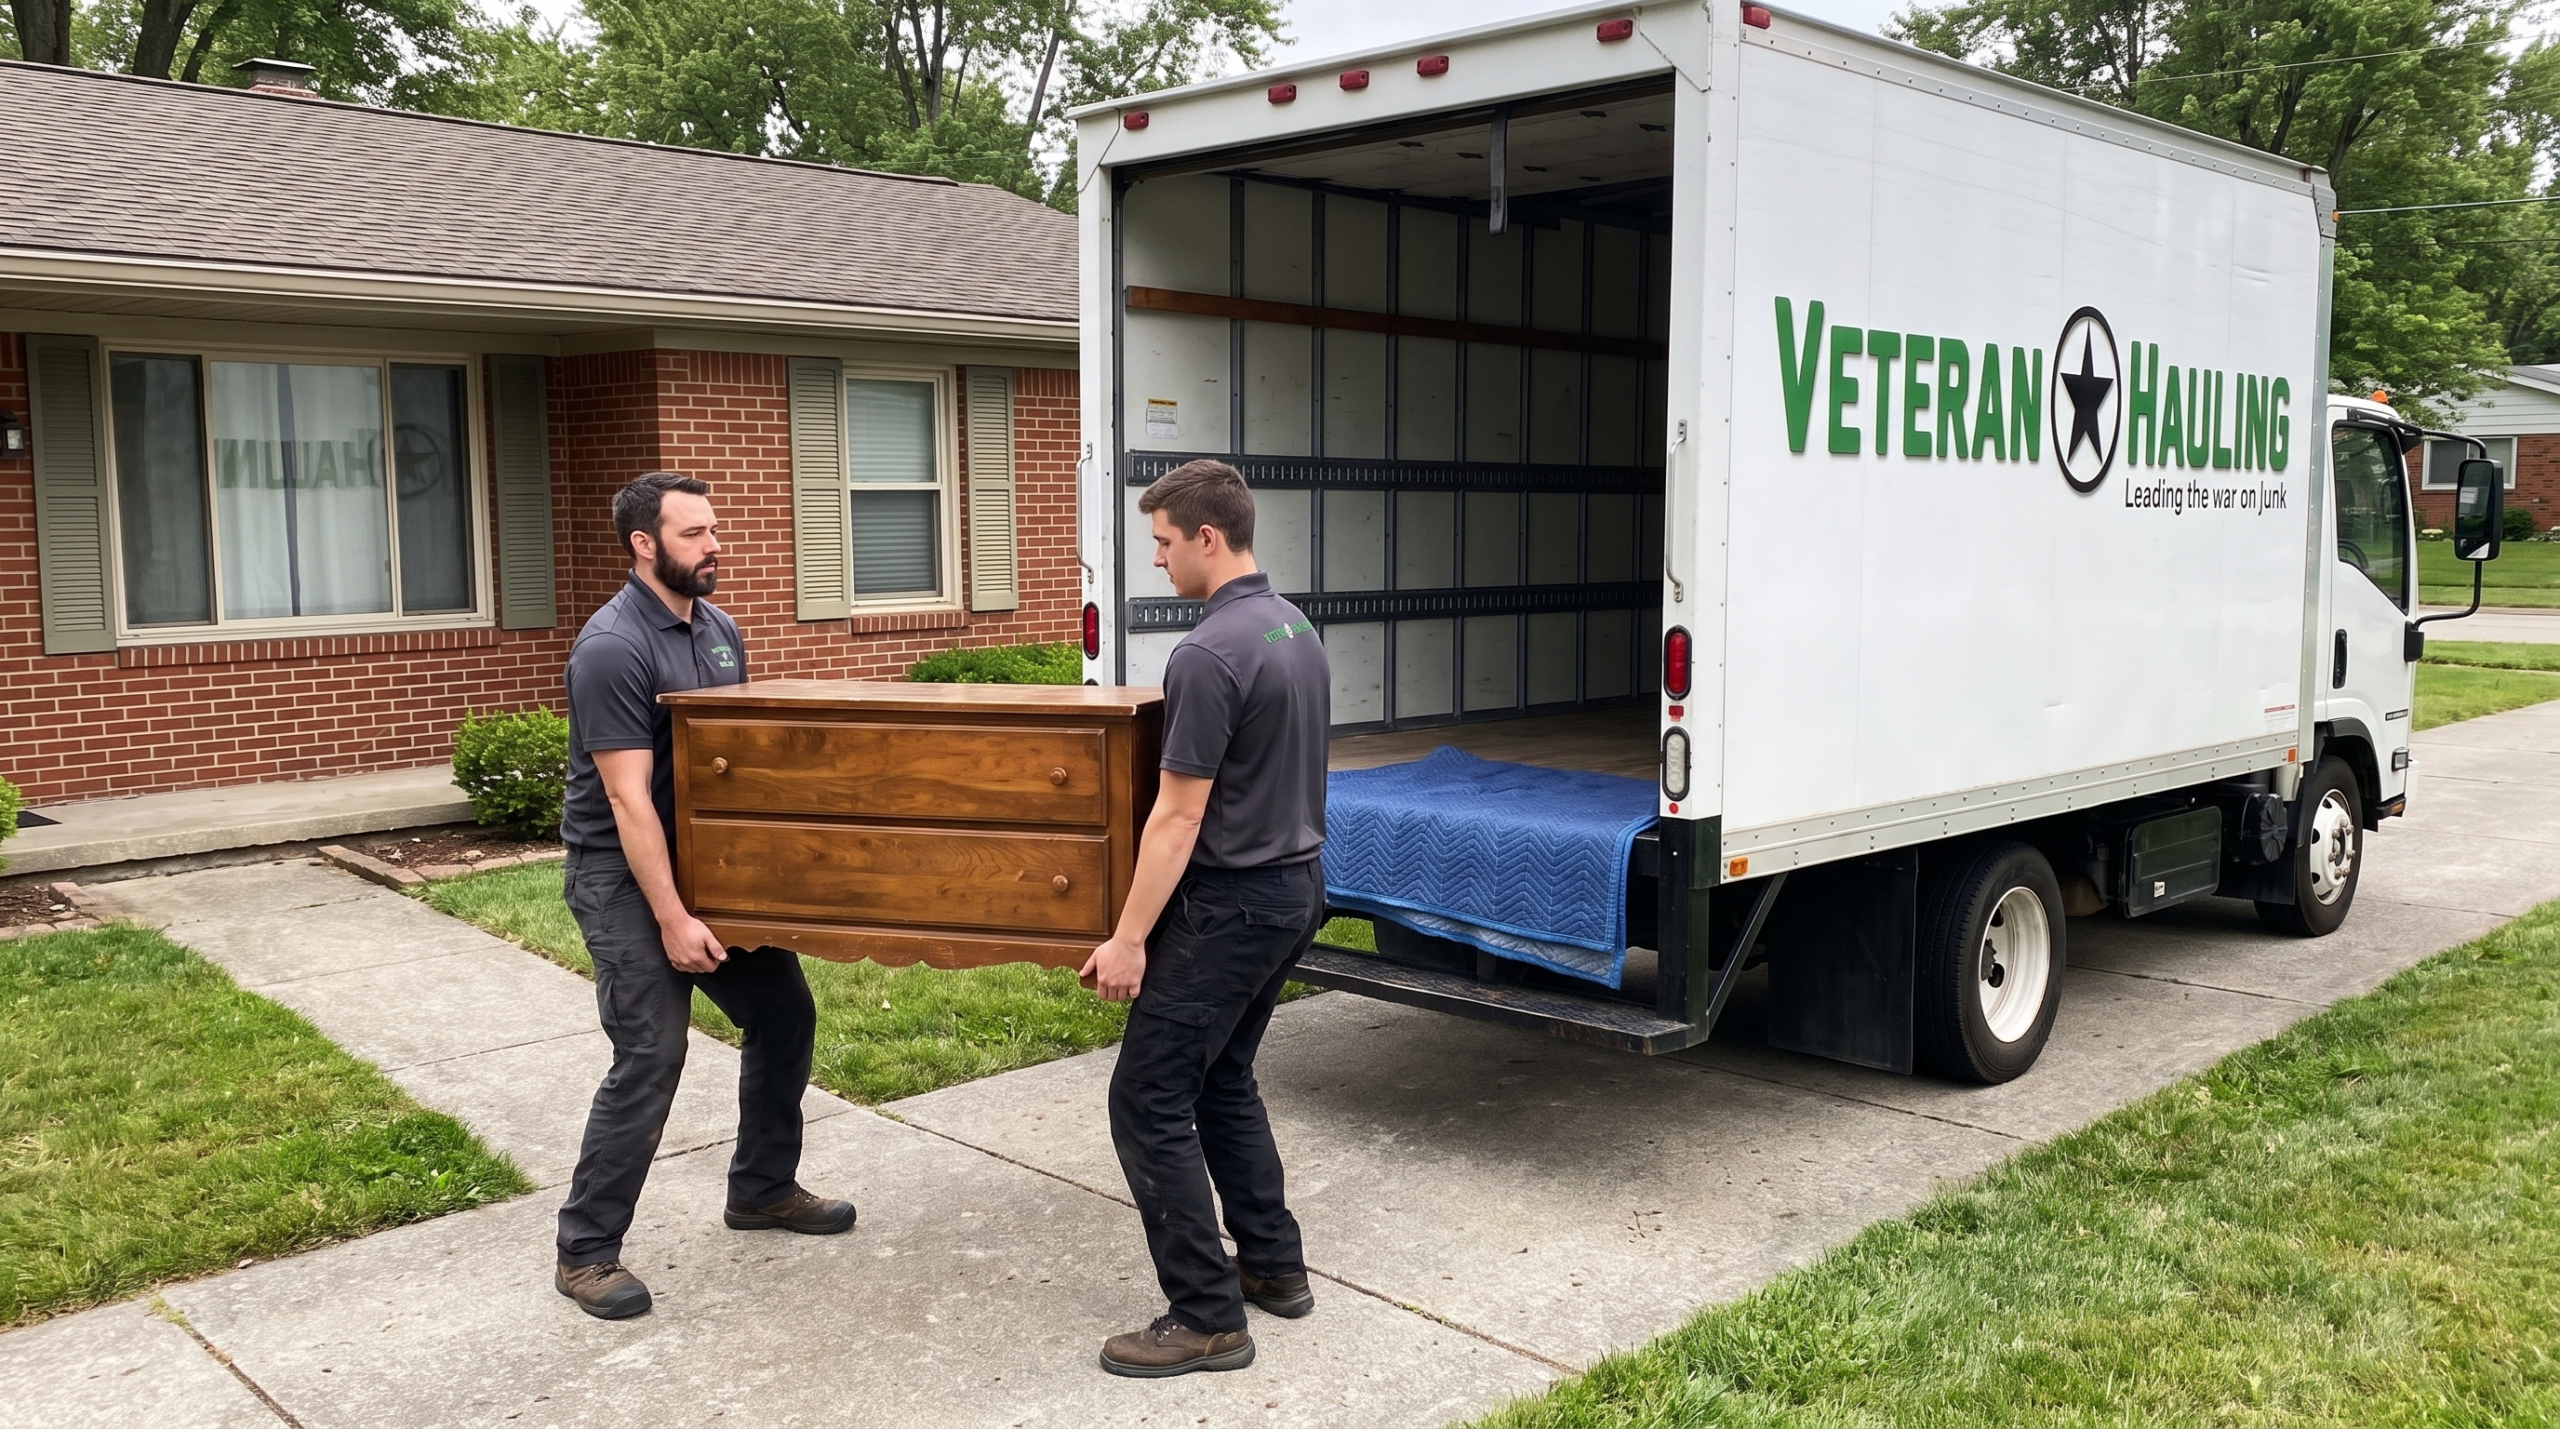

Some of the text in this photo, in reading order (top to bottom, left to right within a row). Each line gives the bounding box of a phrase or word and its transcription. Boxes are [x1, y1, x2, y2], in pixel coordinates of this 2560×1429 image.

[1775, 296, 2290, 470] VETERAN HAULING
[2125, 477, 2183, 516] Leading
[2187, 479, 2209, 509] the
[2212, 488, 2238, 509] war
[2240, 488, 2256, 509] on
